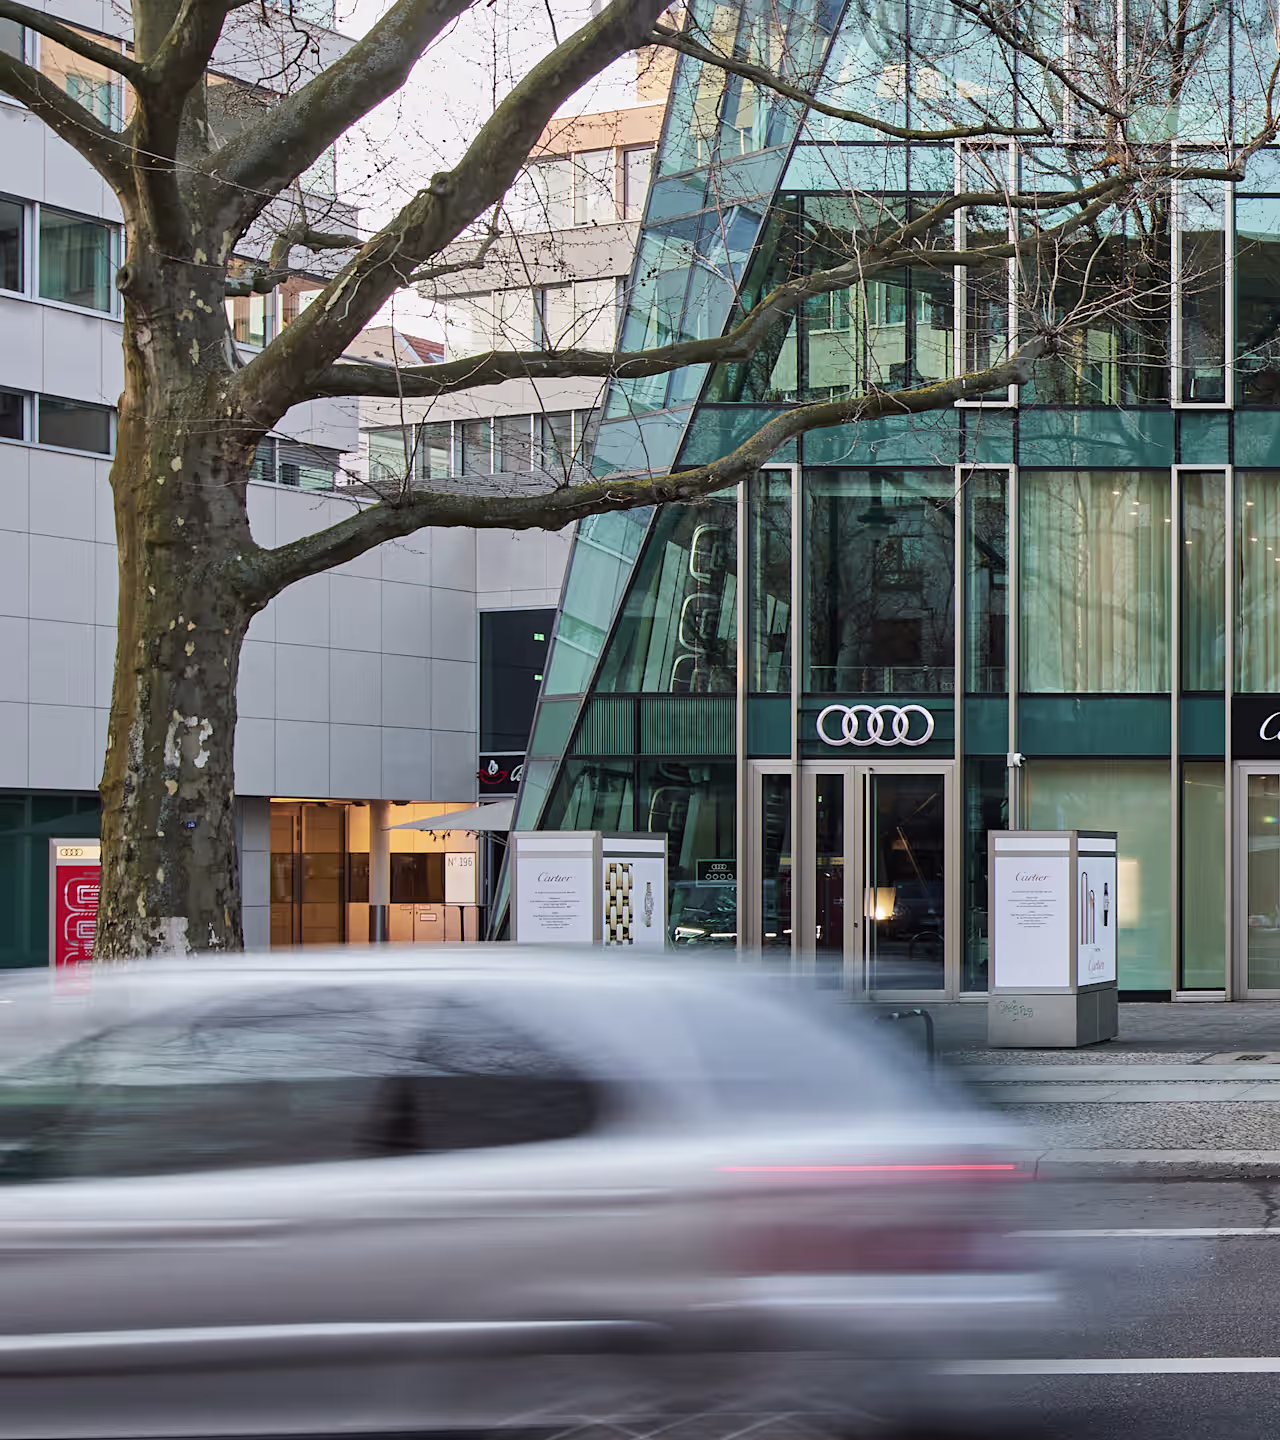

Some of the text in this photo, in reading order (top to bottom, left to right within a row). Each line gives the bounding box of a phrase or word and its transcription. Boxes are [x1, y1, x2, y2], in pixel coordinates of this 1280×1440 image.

[459, 857, 473, 867] 196
[538, 872, 573, 882] Cartier
[1015, 871, 1051, 882] Cartier
